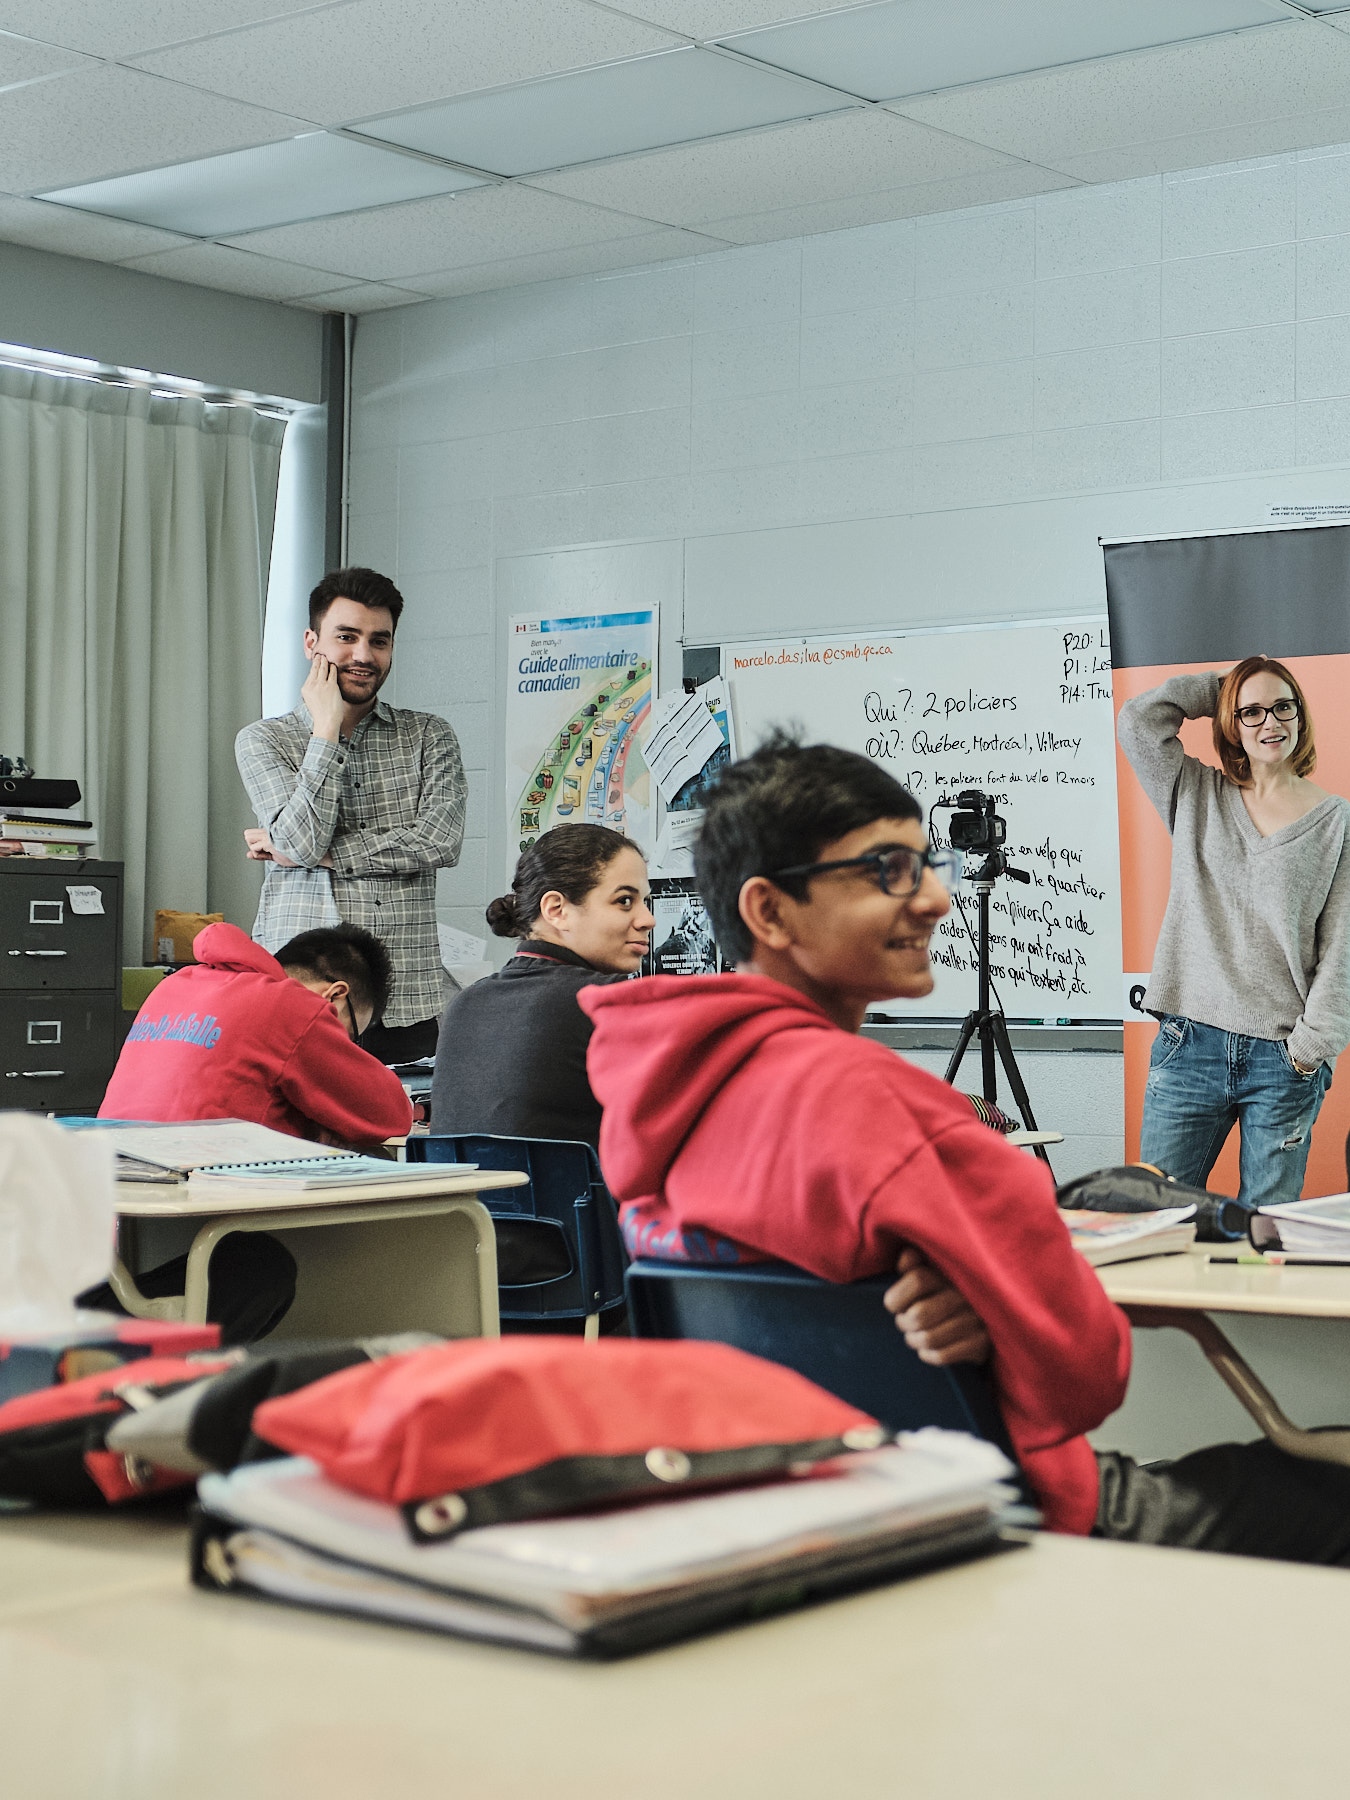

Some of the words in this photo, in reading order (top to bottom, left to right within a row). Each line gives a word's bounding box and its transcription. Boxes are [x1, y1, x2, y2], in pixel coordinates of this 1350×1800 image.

[1062, 632, 1093, 655] P20:
[518, 656, 558, 675] Guide
[559, 649, 638, 672] alimentaire
[518, 674, 581, 694] canadien
[922, 692, 941, 718] 2
[945, 688, 1017, 720] policiers
[1036, 731, 1082, 759] Villeray
[950, 771, 983, 788] policiers
[987, 770, 1007, 785] font
[1009, 771, 1023, 784] du
[1026, 768, 1049, 784] vélo
[1055, 770, 1070, 785] 12
[1070, 771, 1096, 786] mois
[1060, 848, 1083, 868] qui
[1047, 872, 1105, 900] quartier
[1065, 910, 1094, 936] aide
[939, 918, 968, 939] aider
[1010, 936, 1025, 959] qui
[1008, 965, 1026, 988] qui
